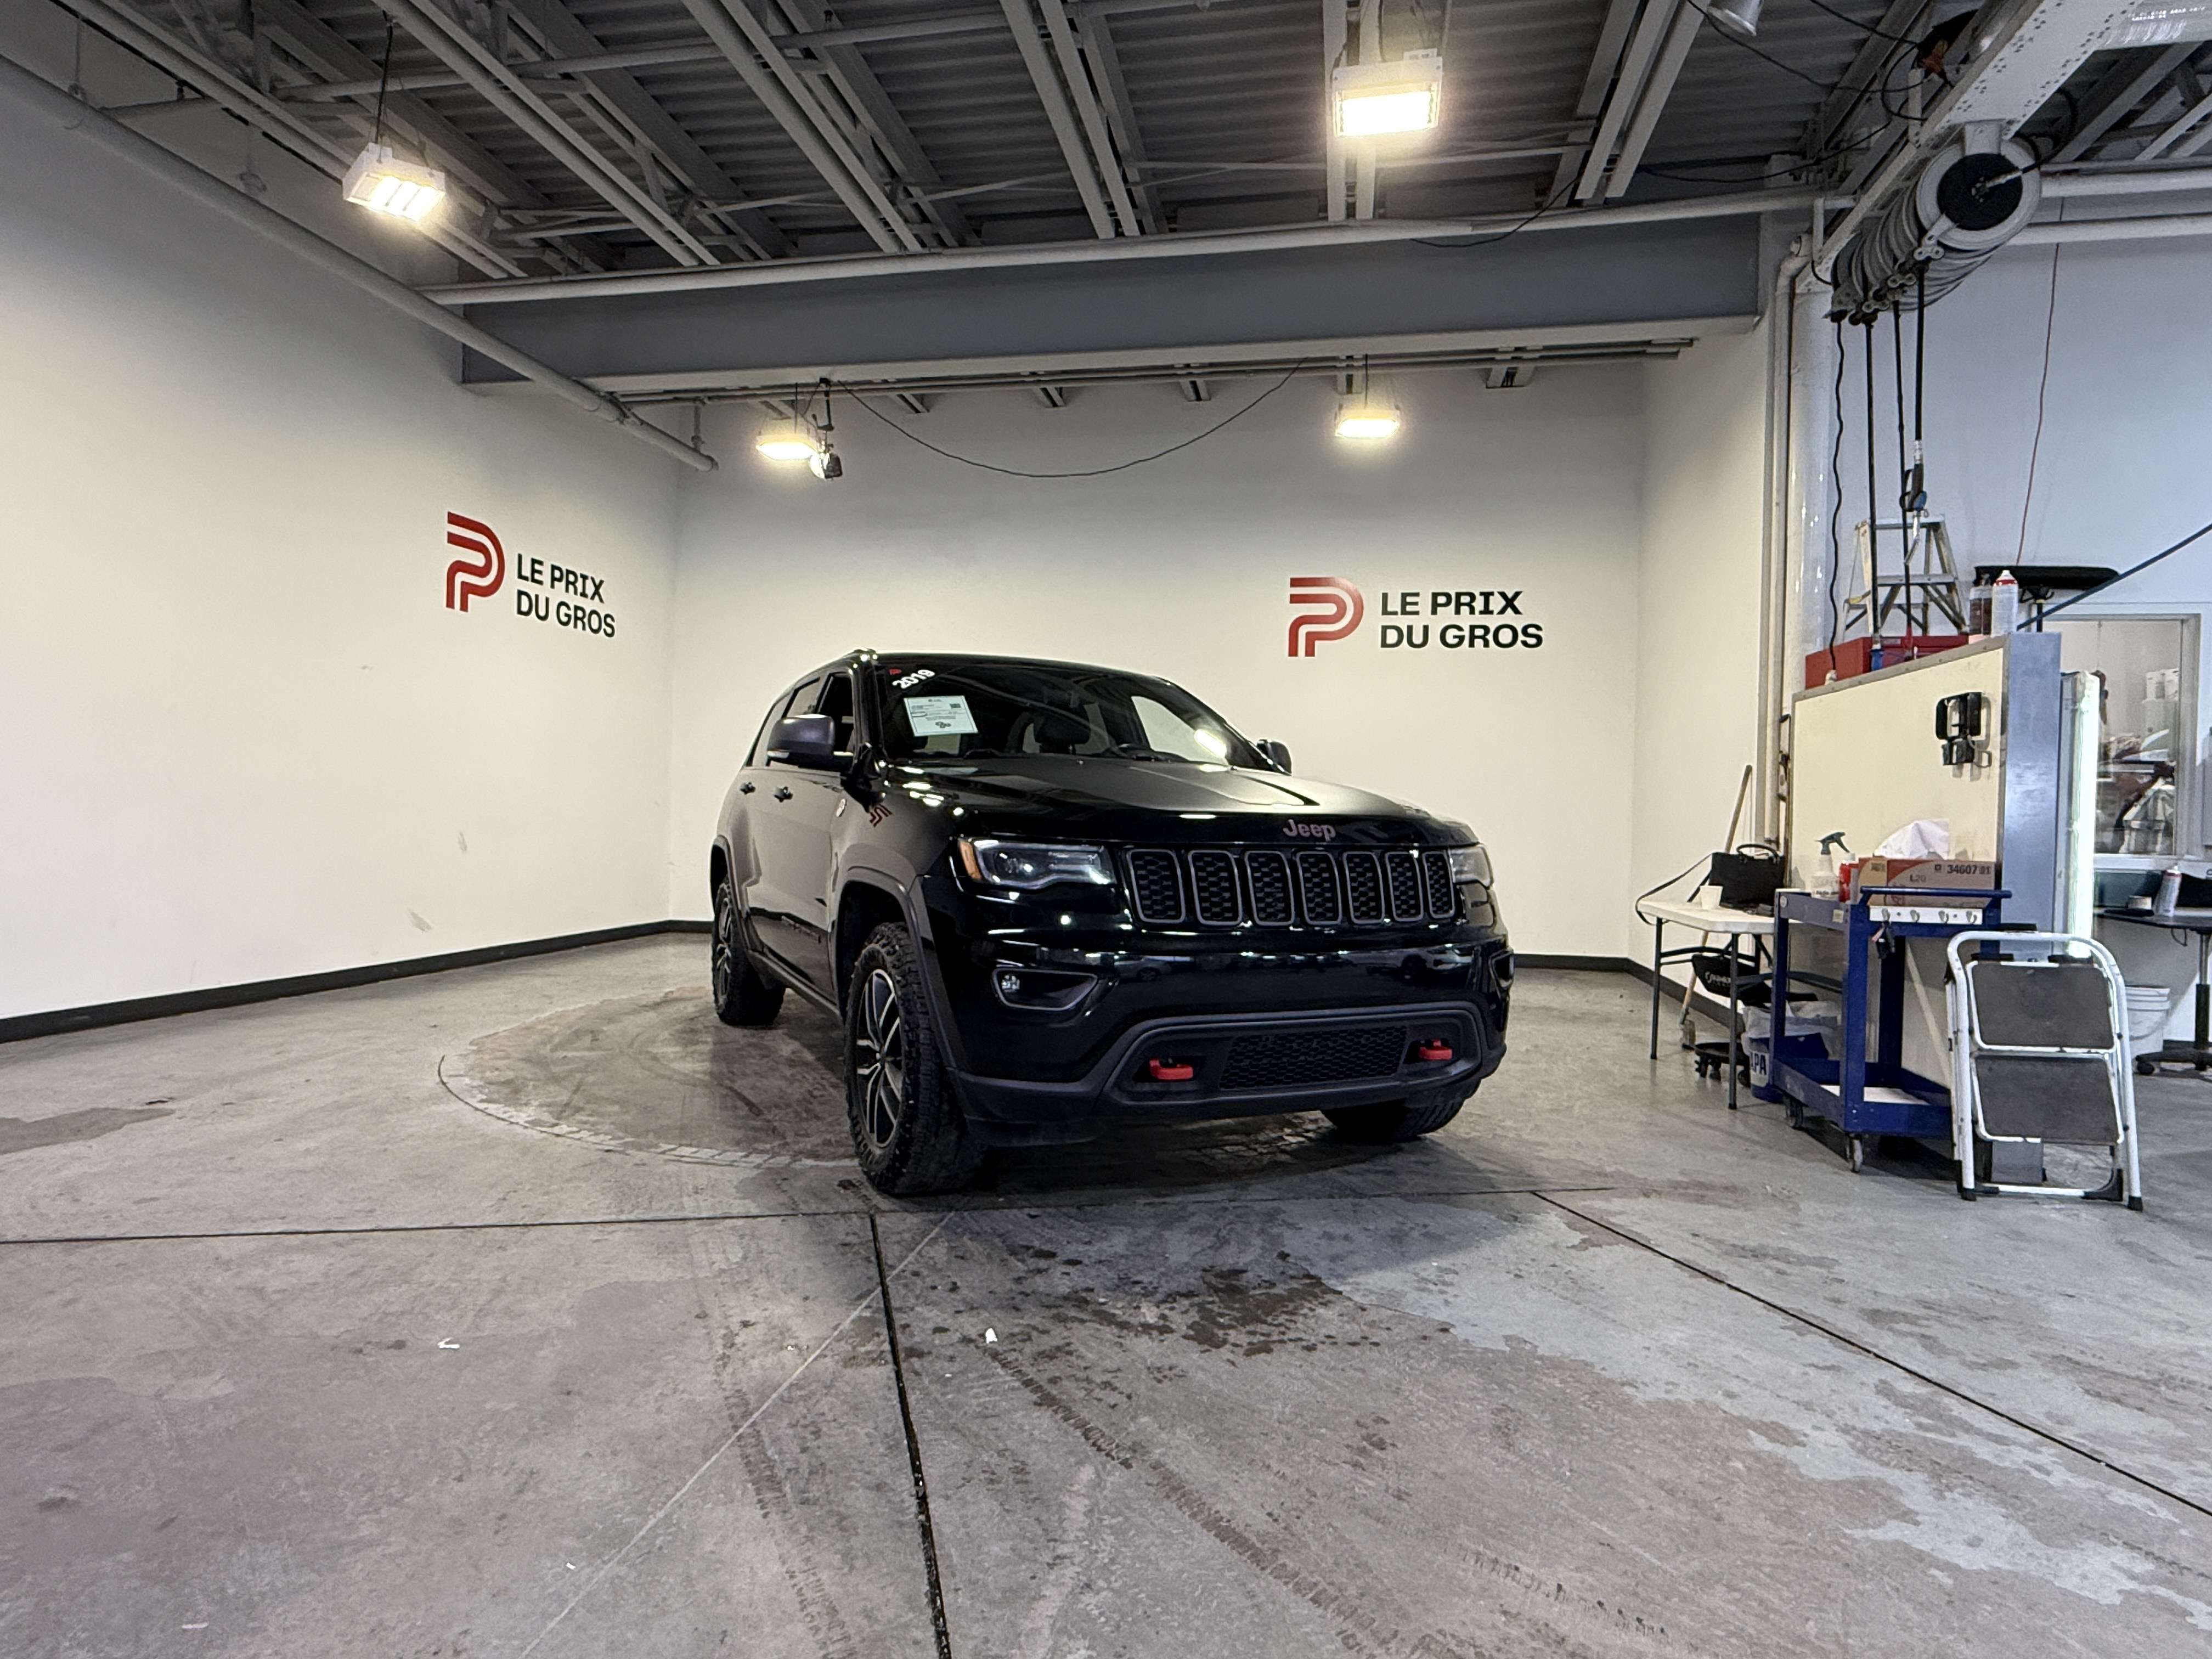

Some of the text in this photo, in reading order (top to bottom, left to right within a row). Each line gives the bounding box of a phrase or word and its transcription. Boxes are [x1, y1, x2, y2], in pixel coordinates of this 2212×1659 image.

[517, 553, 605, 603] LE PRIX
[517, 589, 615, 637] DU GROS
[1381, 591, 1523, 616] LE PRIX
[1380, 624, 1543, 648] DU GROS
[1283, 819, 1336, 842] Jeep
